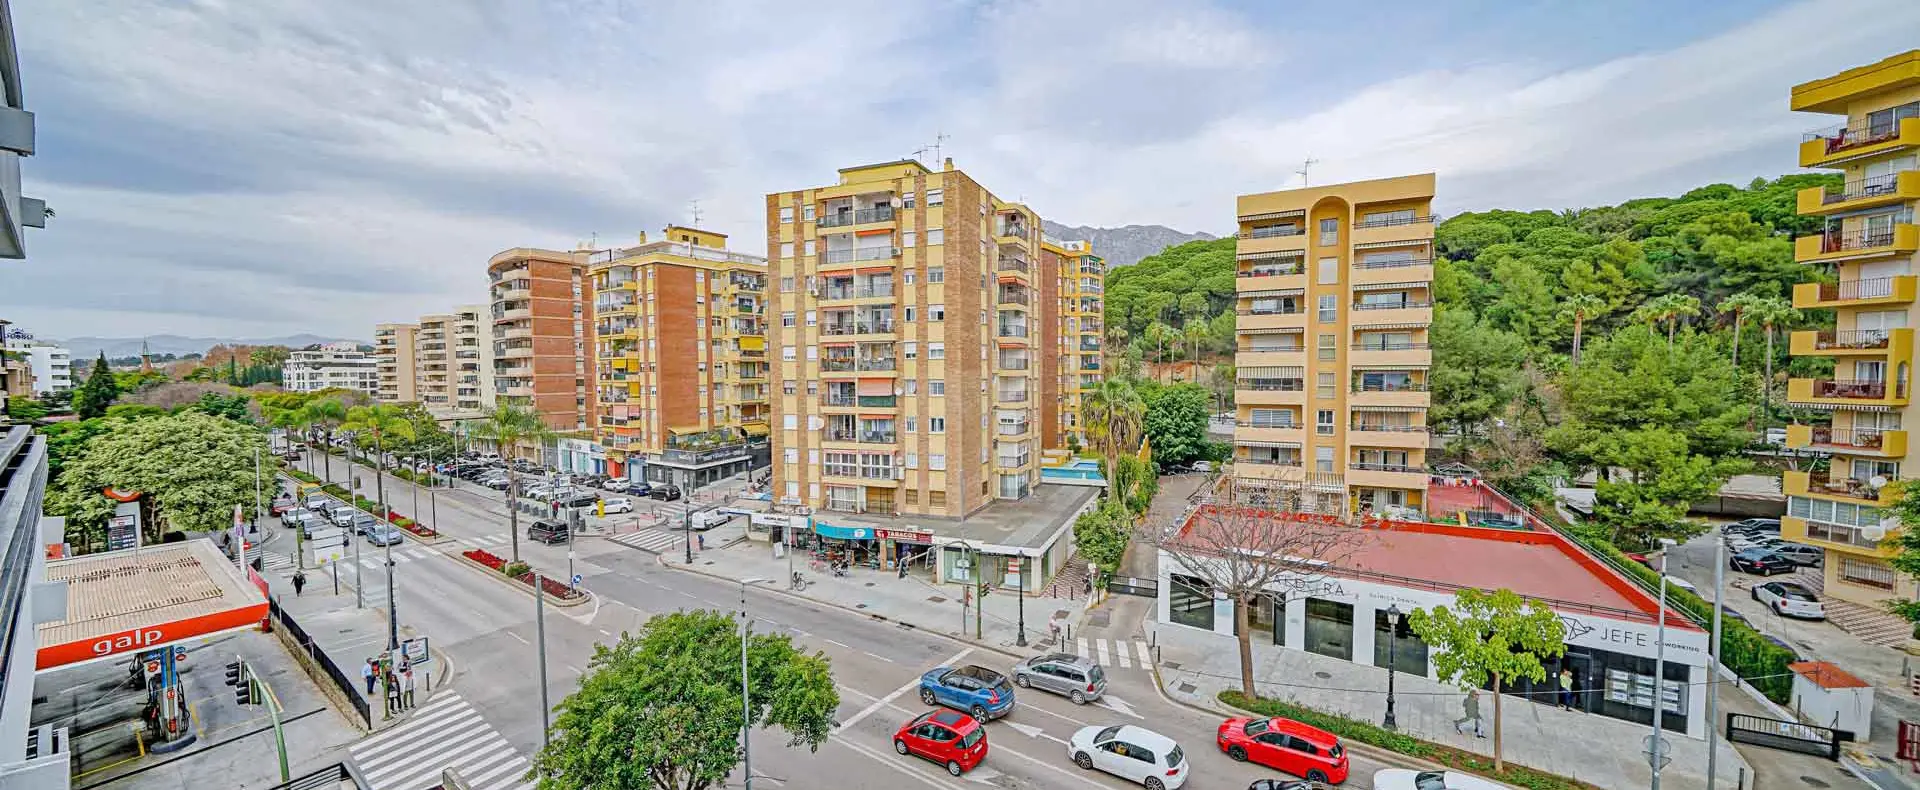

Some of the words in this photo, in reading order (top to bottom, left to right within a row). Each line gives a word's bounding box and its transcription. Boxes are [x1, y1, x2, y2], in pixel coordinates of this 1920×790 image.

[887, 531, 918, 539] TABACOS
[93, 629, 162, 656] galp
[1600, 627, 1647, 647] JEFE
[1654, 640, 1700, 652] CWORKING
